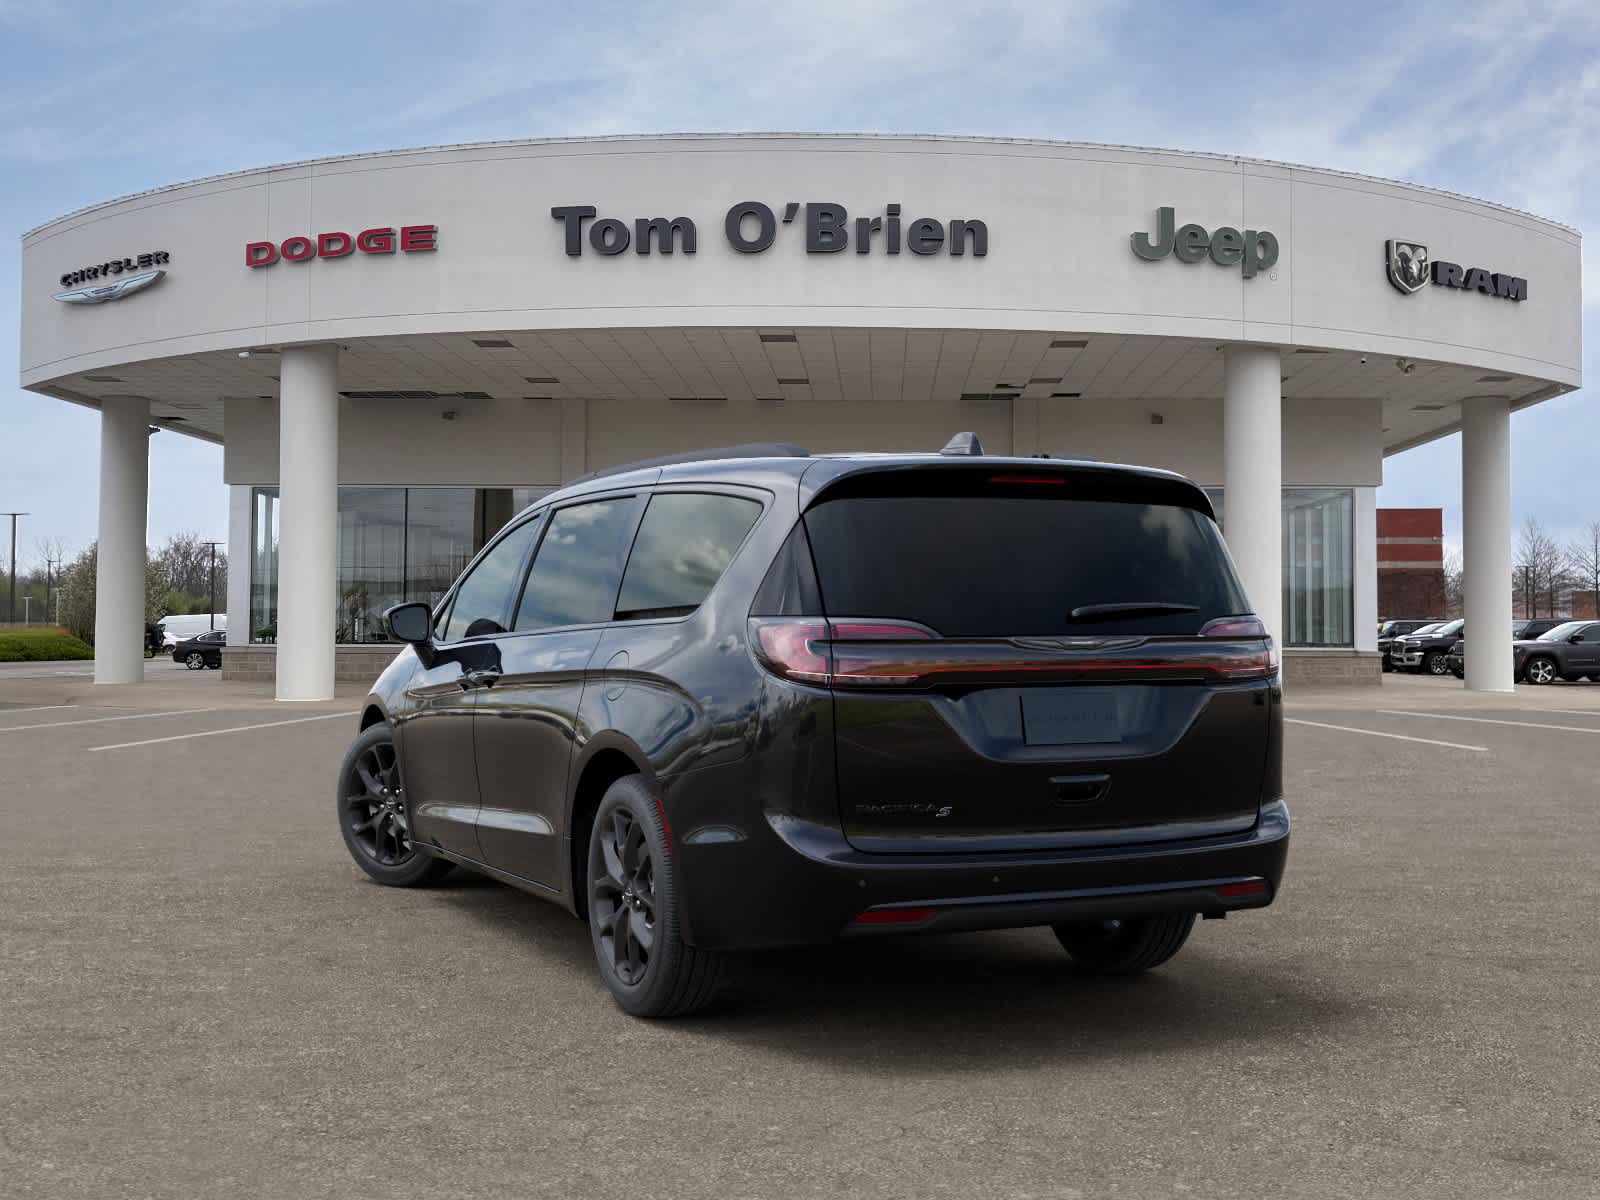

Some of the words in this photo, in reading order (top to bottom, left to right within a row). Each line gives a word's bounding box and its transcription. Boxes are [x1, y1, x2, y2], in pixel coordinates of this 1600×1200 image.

[245, 225, 438, 268] DODGE
[551, 205, 697, 257] Tom
[725, 201, 988, 257] O'Brien
[1130, 206, 1279, 280] Jeep
[60, 251, 169, 286] CHRYSLER
[1431, 260, 1528, 302] RAM
